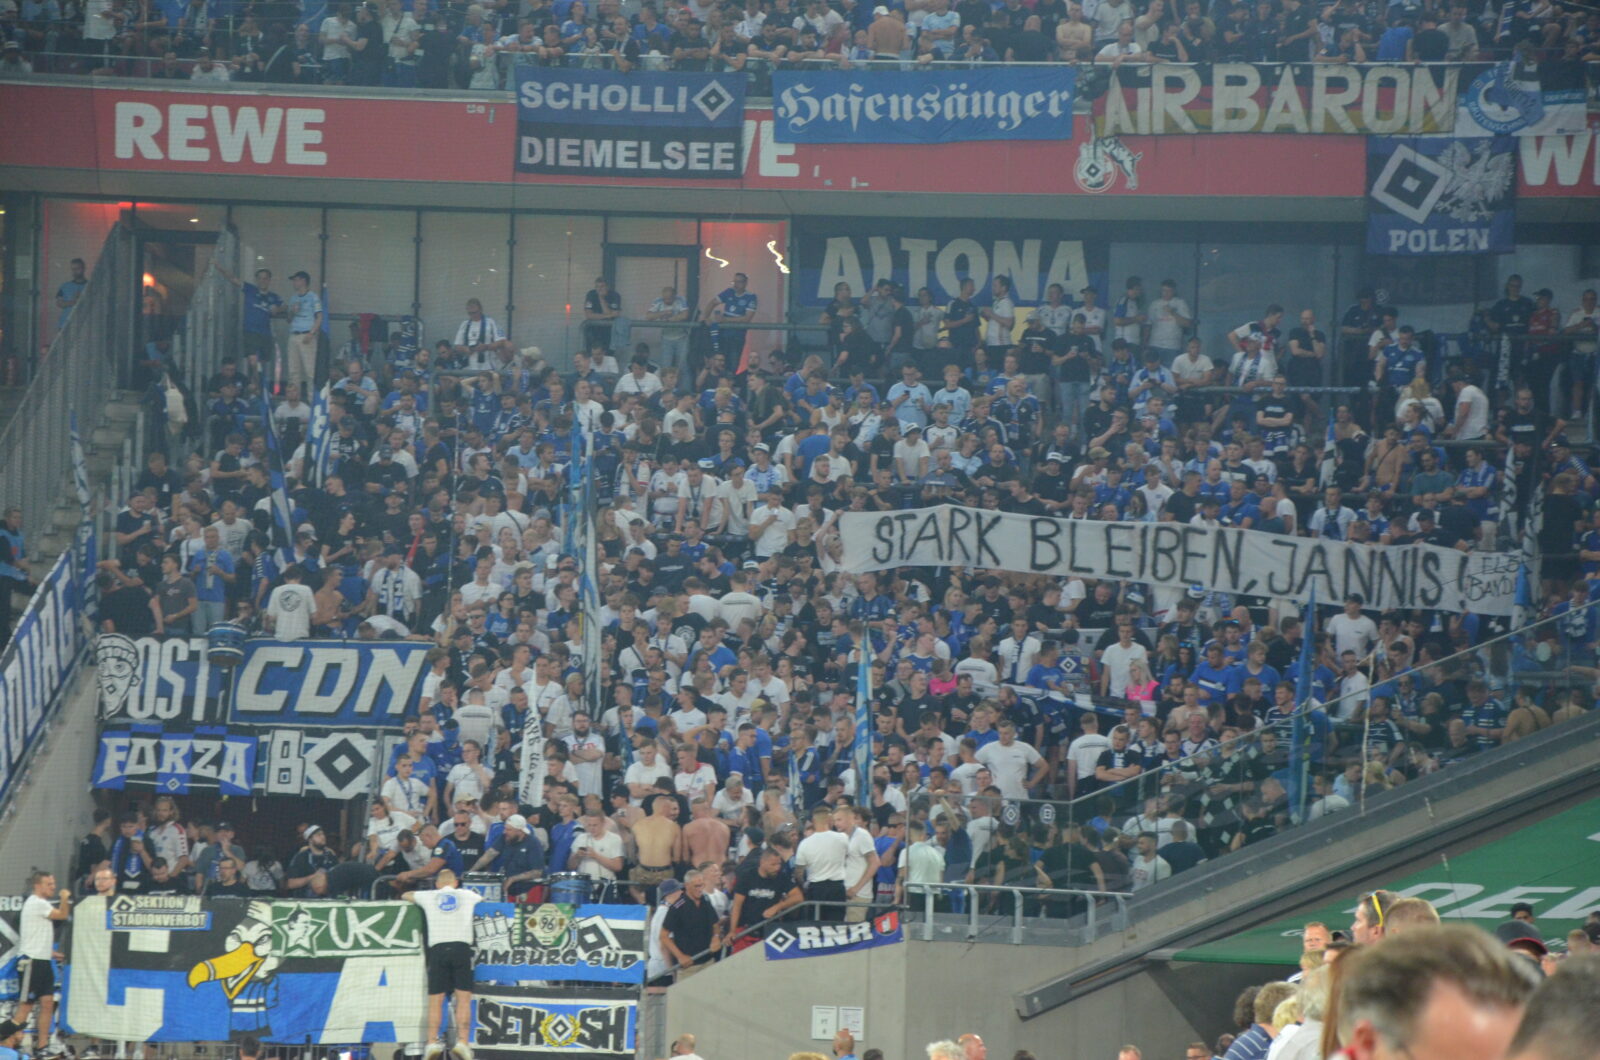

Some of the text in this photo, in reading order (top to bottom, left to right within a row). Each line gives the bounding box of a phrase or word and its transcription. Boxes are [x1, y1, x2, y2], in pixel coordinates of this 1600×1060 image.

[520, 81, 688, 112] SCHOLLI
[777, 83, 1070, 133] Hafensänger
[115, 101, 327, 166] REWE
[520, 136, 735, 170] DIEMELSEE
[1388, 228, 1489, 253] POLEN
[872, 508, 1001, 566] STARK
[236, 647, 428, 714] CDN
[97, 737, 252, 791] FORZA
[135, 896, 185, 909] SEKTION
[112, 913, 207, 927] STADIONVERBOT
[797, 921, 873, 950] RNR
[470, 948, 578, 966] AMBURG
